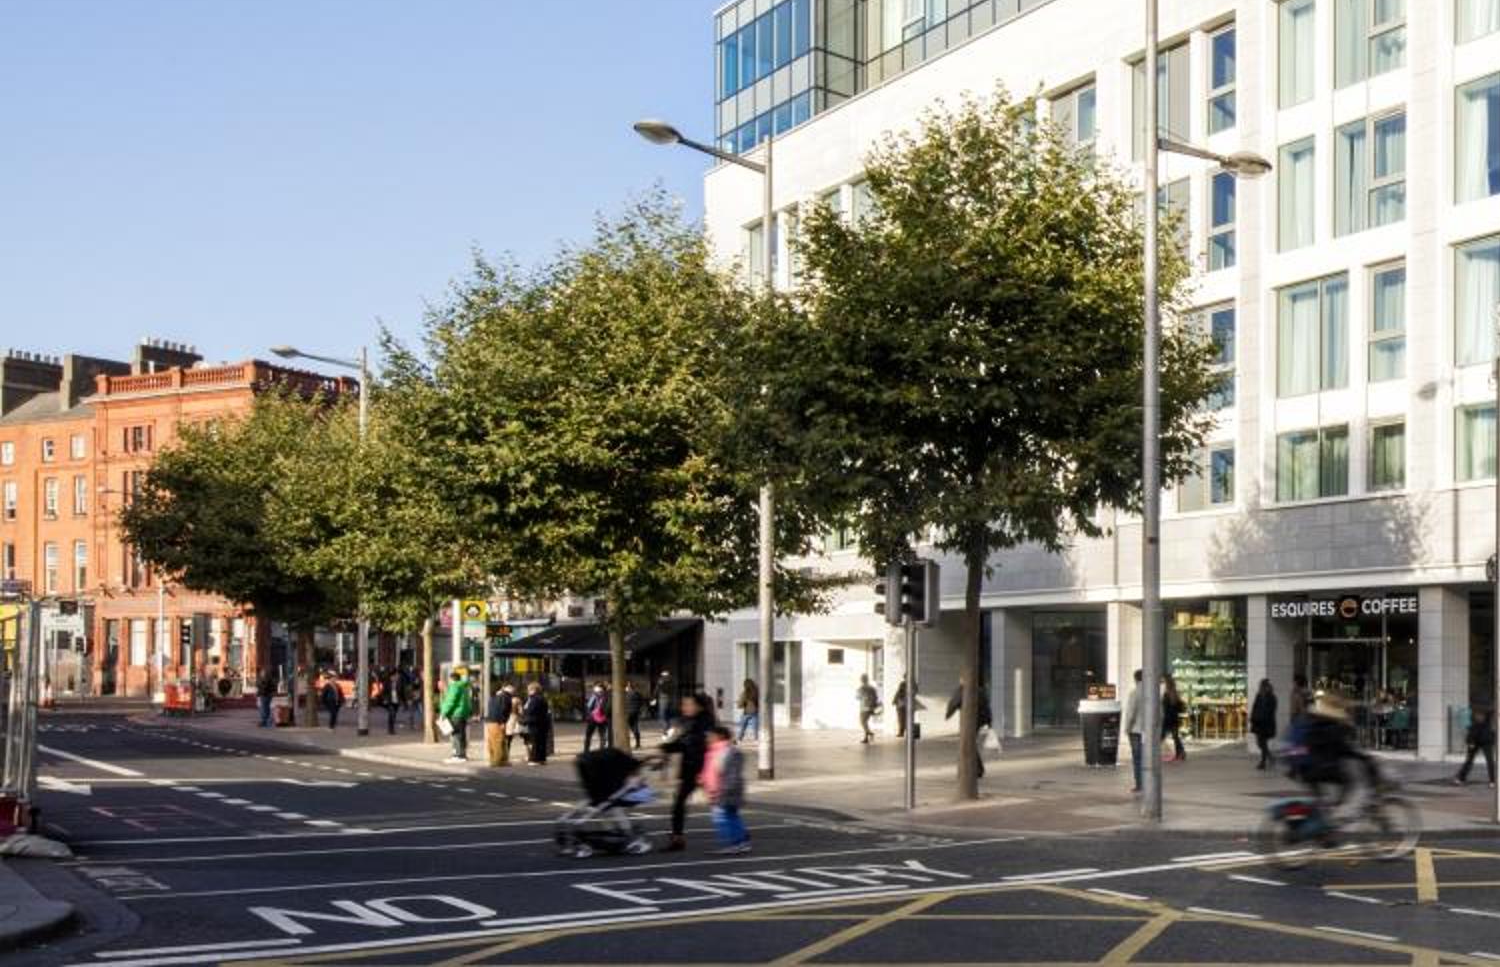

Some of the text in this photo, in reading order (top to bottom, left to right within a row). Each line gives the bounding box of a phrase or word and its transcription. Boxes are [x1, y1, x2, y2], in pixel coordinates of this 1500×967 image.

[1271, 597, 1418, 618] ESQUIRES COFFEE
[248, 860, 973, 935] NO ENTRY
